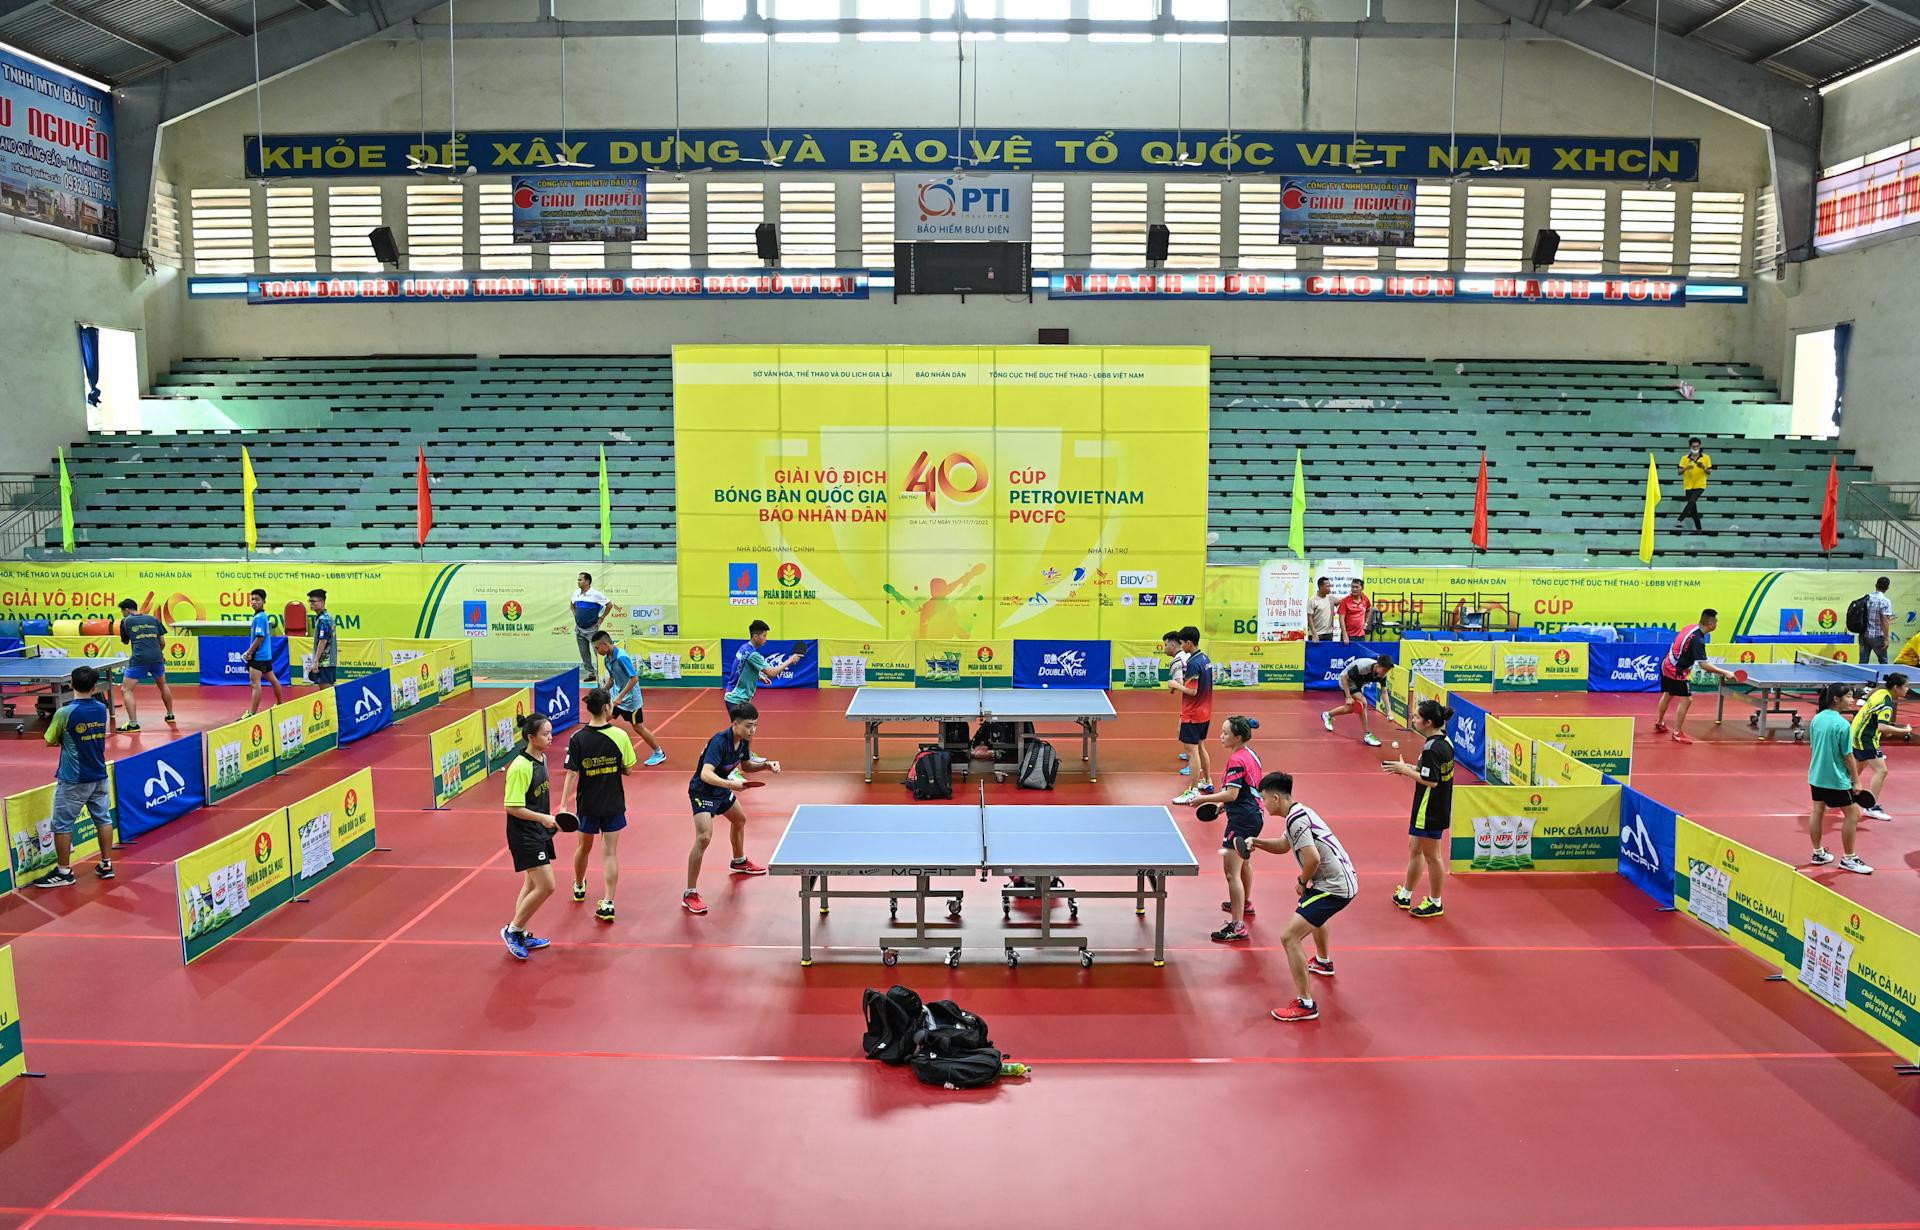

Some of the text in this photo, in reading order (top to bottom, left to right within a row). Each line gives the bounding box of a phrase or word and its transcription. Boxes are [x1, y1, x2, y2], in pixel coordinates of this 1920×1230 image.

[2, 63, 35, 91] TNHH
[37, 76, 61, 100] MTV
[63, 84, 86, 110] ĐẦU
[28, 106, 109, 161] NGUYỄN
[262, 137, 388, 170] KHỎE
[491, 137, 589, 167] XÂY
[609, 135, 741, 172] DỰNG
[760, 133, 827, 165] VÀ
[849, 132, 949, 164] BẢO
[968, 134, 1033, 171] VỆ
[1055, 131, 1119, 165] TỔ
[1140, 133, 1276, 167] QUỐC
[1295, 138, 1407, 175] VIỆT
[1428, 146, 1532, 170] NAM
[1552, 147, 1680, 174] XHCN
[16, 140, 111, 184] QUẢNG CÁO MÀN HÌNH LED
[541, 188, 643, 208] GIÀU NGUYỄN
[961, 188, 1010, 212] PTI
[1309, 192, 1413, 211] GIÀU NGUYỄN
[1840, 193, 1857, 231] THI
[917, 222, 1010, 236] BẢO HIỂM BƯU ĐIỆN
[259, 277, 310, 299] TOÀN
[316, 277, 358, 298] DÂN
[362, 276, 400, 297] RÈN
[405, 276, 467, 301] LUYỆN
[472, 276, 527, 297] THÂN
[531, 272, 570, 295] THỂ
[573, 275, 625, 296] THEO
[631, 275, 702, 295] GƯƠNG
[708, 273, 751, 295] BÁC
[755, 271, 788, 295] HỒ
[790, 275, 817, 294] VĨ
[1063, 272, 1673, 302] NHANH HƠN CAO HƠN MẠNH HƠN
[916, 370, 966, 378] BÁO NHÂN DÂN
[774, 467, 887, 487] GIẢI VÔ ĐỊCH
[904, 450, 990, 513] 40
[1009, 467, 1046, 484] CÚP
[714, 484, 887, 504] BÓNG BÀN QUỐC GIA
[1009, 490, 1144, 504] PETROVIETNAM
[759, 504, 887, 522] BÁO NHÂN DÂN
[1009, 510, 1066, 523] PVCFC
[16, 569, 29, 578] THỂ
[31, 570, 50, 578] THAO
[51, 569, 60, 578] VÀ
[71, 570, 89, 580] LỊCH
[139, 570, 192, 578] BÁO NHÂN DÂN
[216, 571, 236, 579] TỔNG
[237, 572, 251, 580] CỤC
[252, 571, 267, 579] THỂ
[268, 572, 283, 580] DỤC
[285, 571, 299, 579] THỂ
[347, 571, 363, 580] VIỆT
[1120, 576, 1145, 584] BIDV
[1366, 577, 1425, 586] DU LỊCH GIA LAI
[1450, 576, 1507, 585] BÁO NHÂN DÂN
[1532, 577, 1551, 586] TỔNG
[1553, 579, 1569, 587] CỤC
[1571, 577, 1585, 586] THỂ
[1586, 579, 1601, 587] DỤC
[1603, 577, 1618, 586] THỂ
[1620, 579, 1640, 587] THAO
[1666, 578, 1682, 588] VIỆT
[1683, 579, 1701, 587] NAM
[2, 588, 115, 610] GIẢI VÔ ĐỊCH
[763, 589, 780, 599] PHÂN
[803, 590, 816, 599] MAU
[1163, 594, 1195, 605] KRT
[632, 609, 653, 618] BIDV
[1375, 599, 1424, 617] ĐỊCH
[1534, 595, 1574, 615] CÚP
[1038, 666, 1087, 677] DOUBLE FISH
[1274, 662, 1284, 670] CÀ
[780, 671, 794, 679] FISH
[1611, 670, 1659, 680] DOUBLE FISH
[354, 706, 383, 724] MOFIT
[1590, 747, 1606, 756] CÀ
[145, 786, 187, 810] MOFIT
[1495, 834, 1513, 843] NPK
[1543, 824, 1609, 836] NPK CÀ MAU
[1620, 846, 1660, 874] MOFIT
[891, 868, 957, 877] MOFIT
[1735, 890, 1753, 908] NPK
[1752, 899, 1764, 914] CÀ
[1765, 905, 1785, 923] MAU
[1857, 962, 1917, 1006] NPK CÀ MAU
